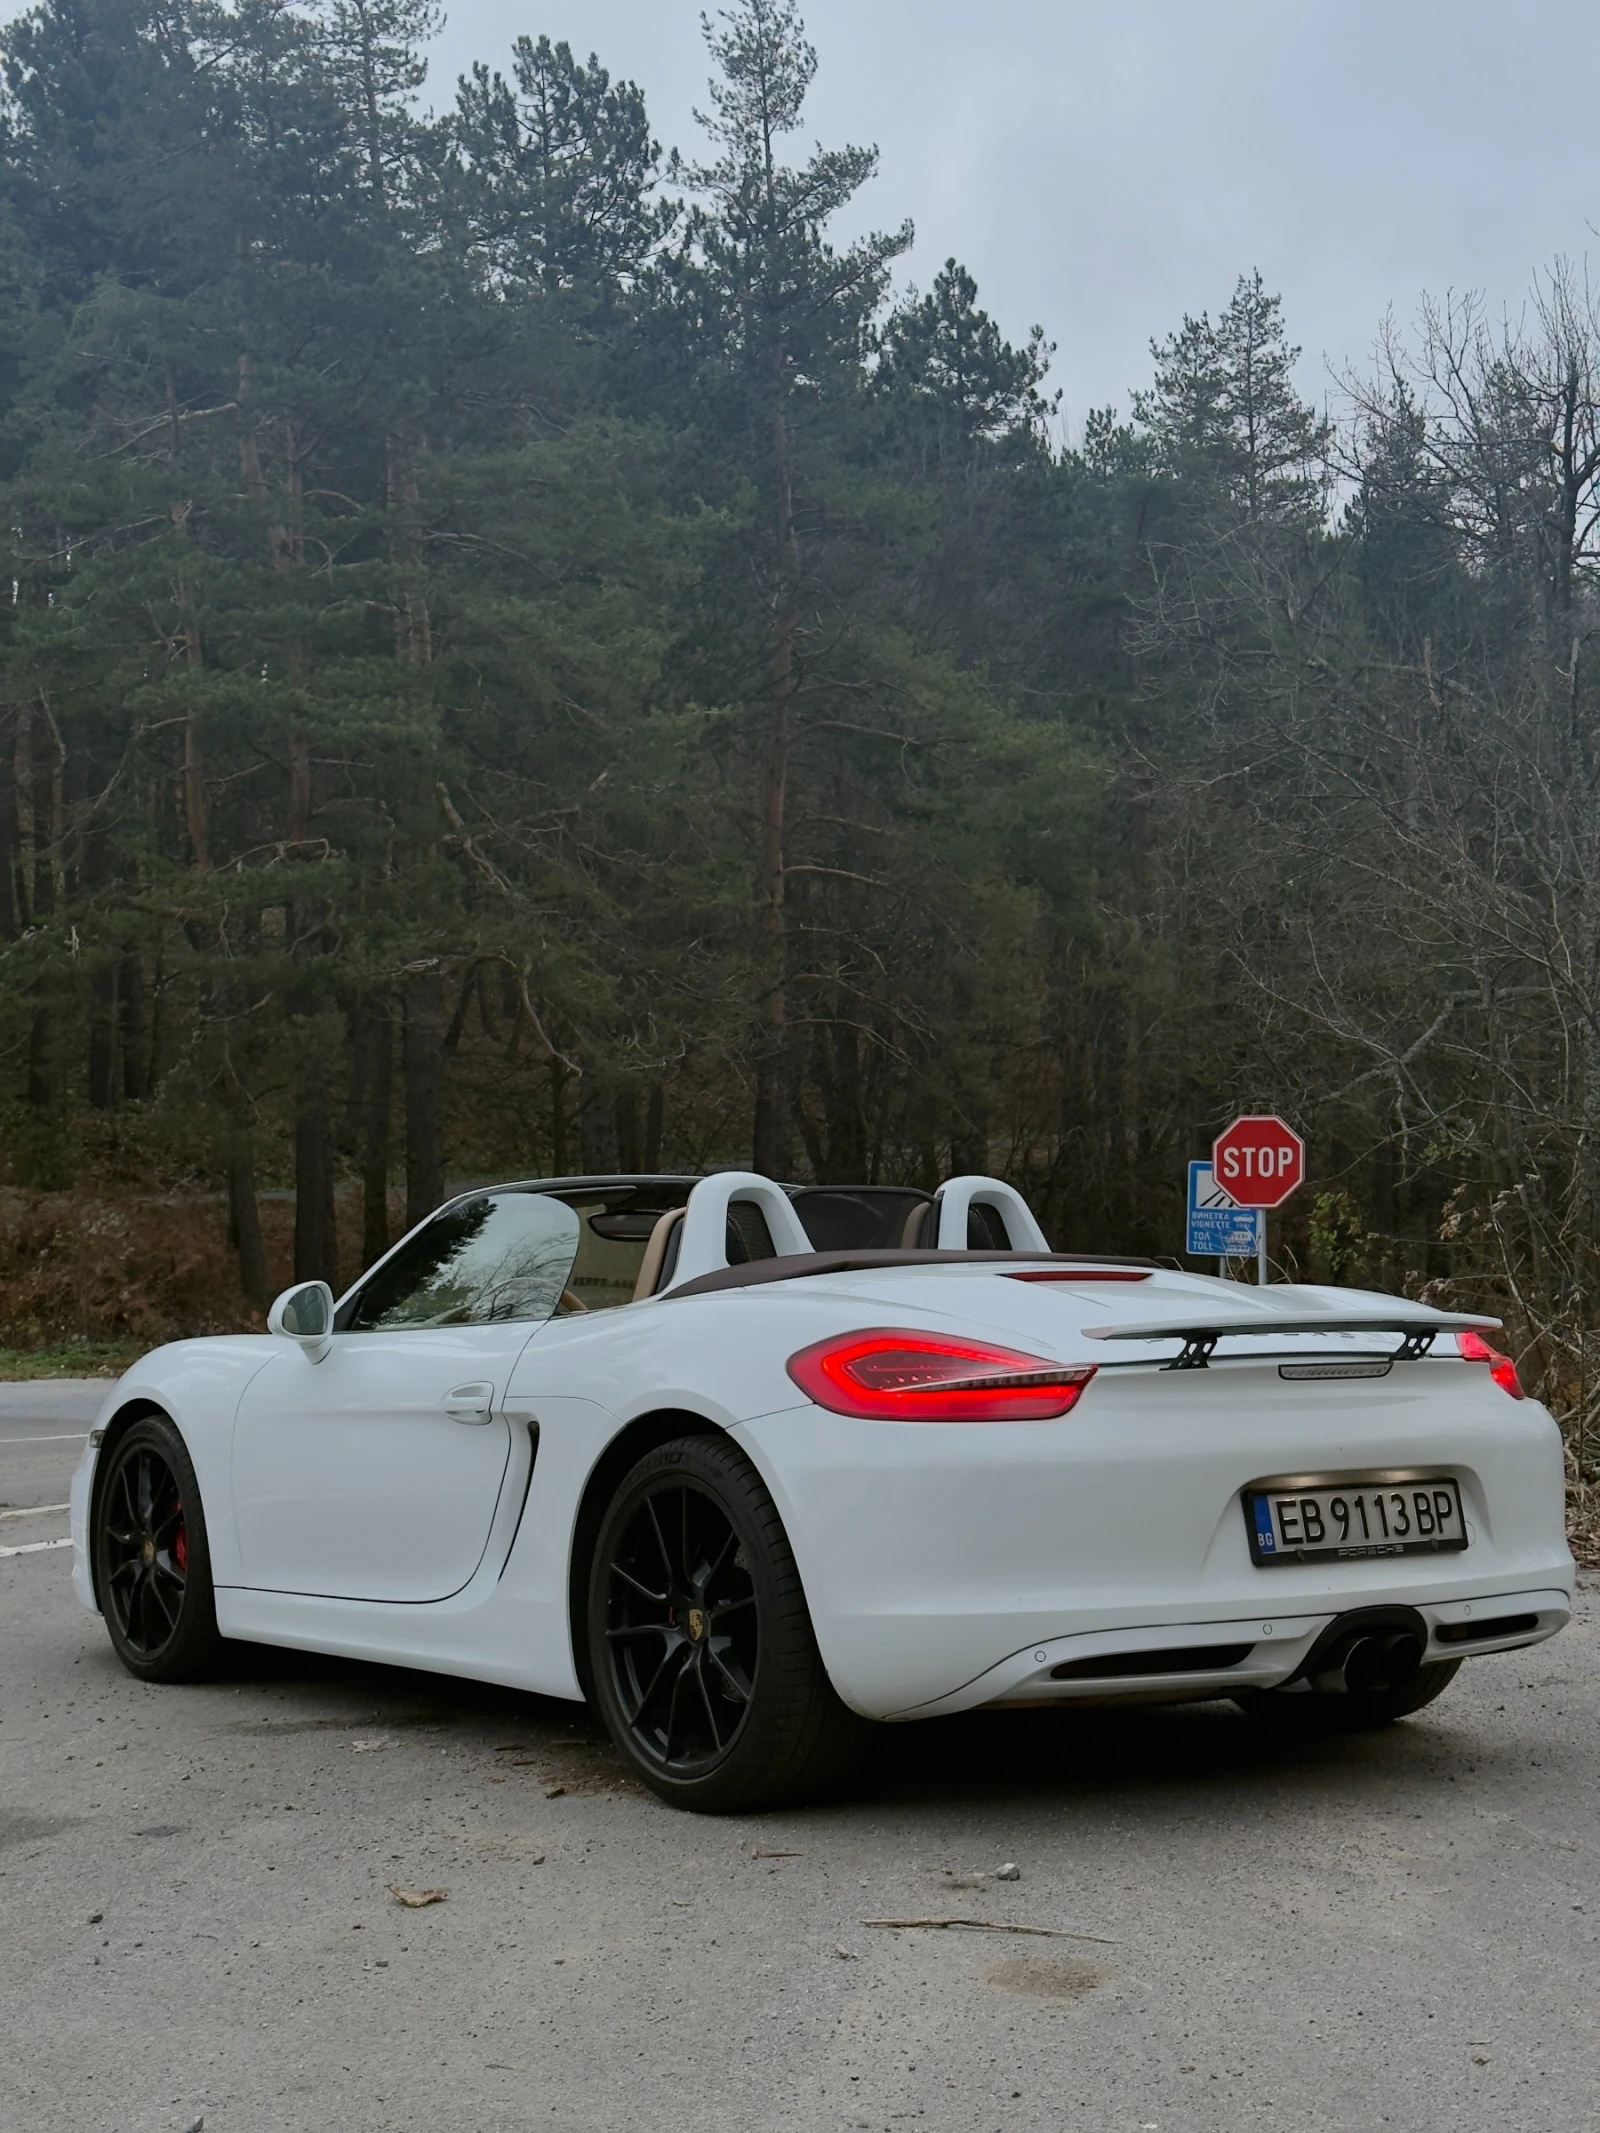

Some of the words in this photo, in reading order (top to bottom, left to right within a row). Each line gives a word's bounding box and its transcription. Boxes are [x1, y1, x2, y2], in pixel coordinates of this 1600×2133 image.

[1223, 1146, 1293, 1178] STOP
[1192, 1211, 1230, 1220] ВИНЕТКА
[1193, 1231, 1210, 1241] ТОЛ
[1192, 1241, 1214, 1251] TOLL
[1276, 1499, 1326, 1545] EB
[1329, 1493, 1411, 1541] 9113
[1412, 1491, 1452, 1535] BP
[1258, 1533, 1273, 1546] BG
[1338, 1544, 1404, 1558] PORSCHE
